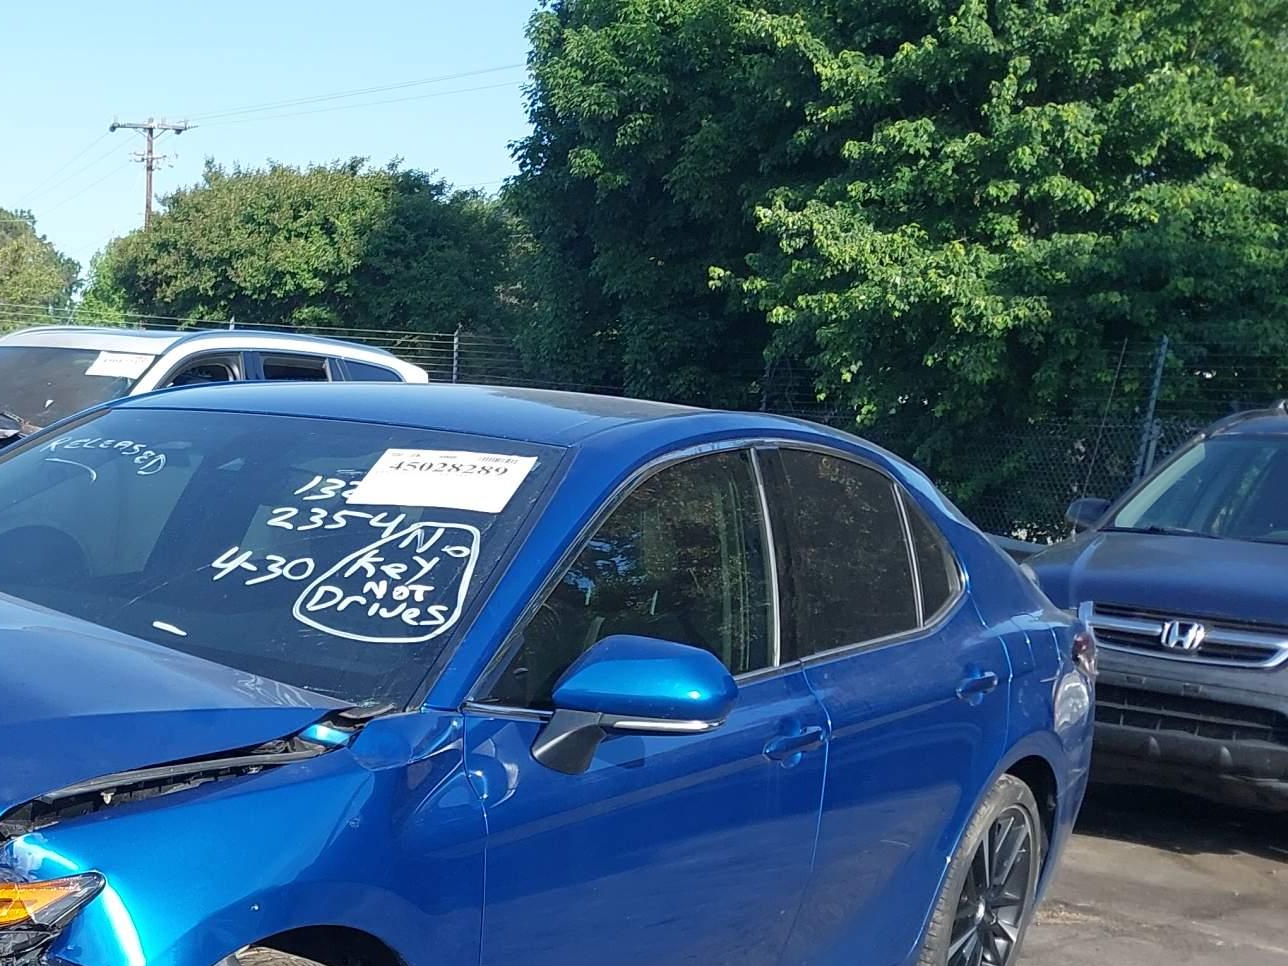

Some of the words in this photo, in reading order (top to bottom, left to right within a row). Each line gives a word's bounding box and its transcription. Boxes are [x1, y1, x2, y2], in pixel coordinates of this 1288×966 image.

[40, 437, 166, 475] RELEASED
[389, 460, 508, 476] 45028289
[267, 507, 406, 539] 2354
[211, 546, 315, 585] 4-30
